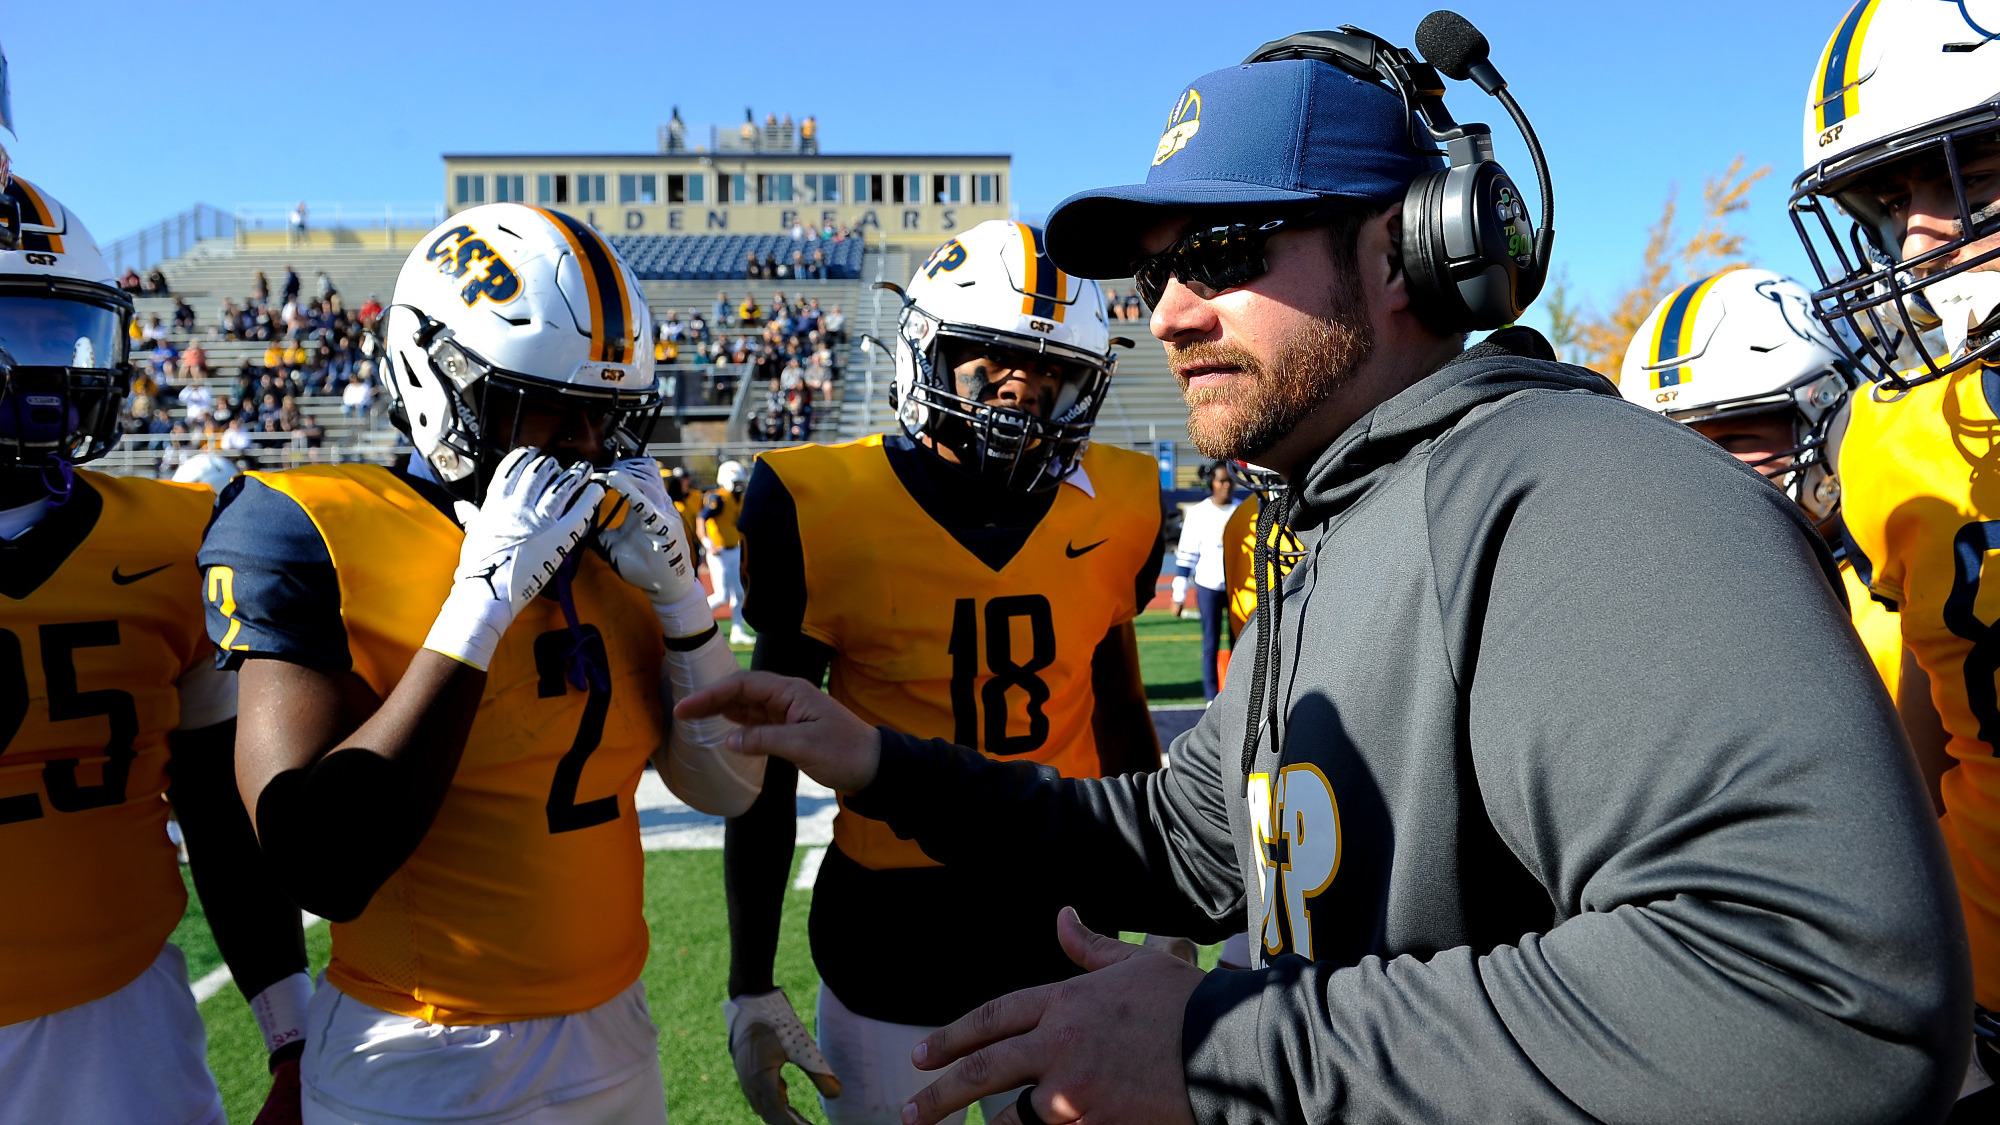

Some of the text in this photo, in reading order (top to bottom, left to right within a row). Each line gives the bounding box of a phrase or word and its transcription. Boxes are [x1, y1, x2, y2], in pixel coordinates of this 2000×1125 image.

[1819, 125, 1843, 147] CSP
[588, 210, 957, 230] LDEN BEARS
[1504, 225, 1516, 236] TD
[25, 253, 58, 266] CSP
[426, 224, 523, 308] CSP
[1030, 319, 1055, 334] CSP
[601, 368, 626, 382] CSP
[948, 594, 1056, 756] 18
[533, 623, 621, 834] 2
